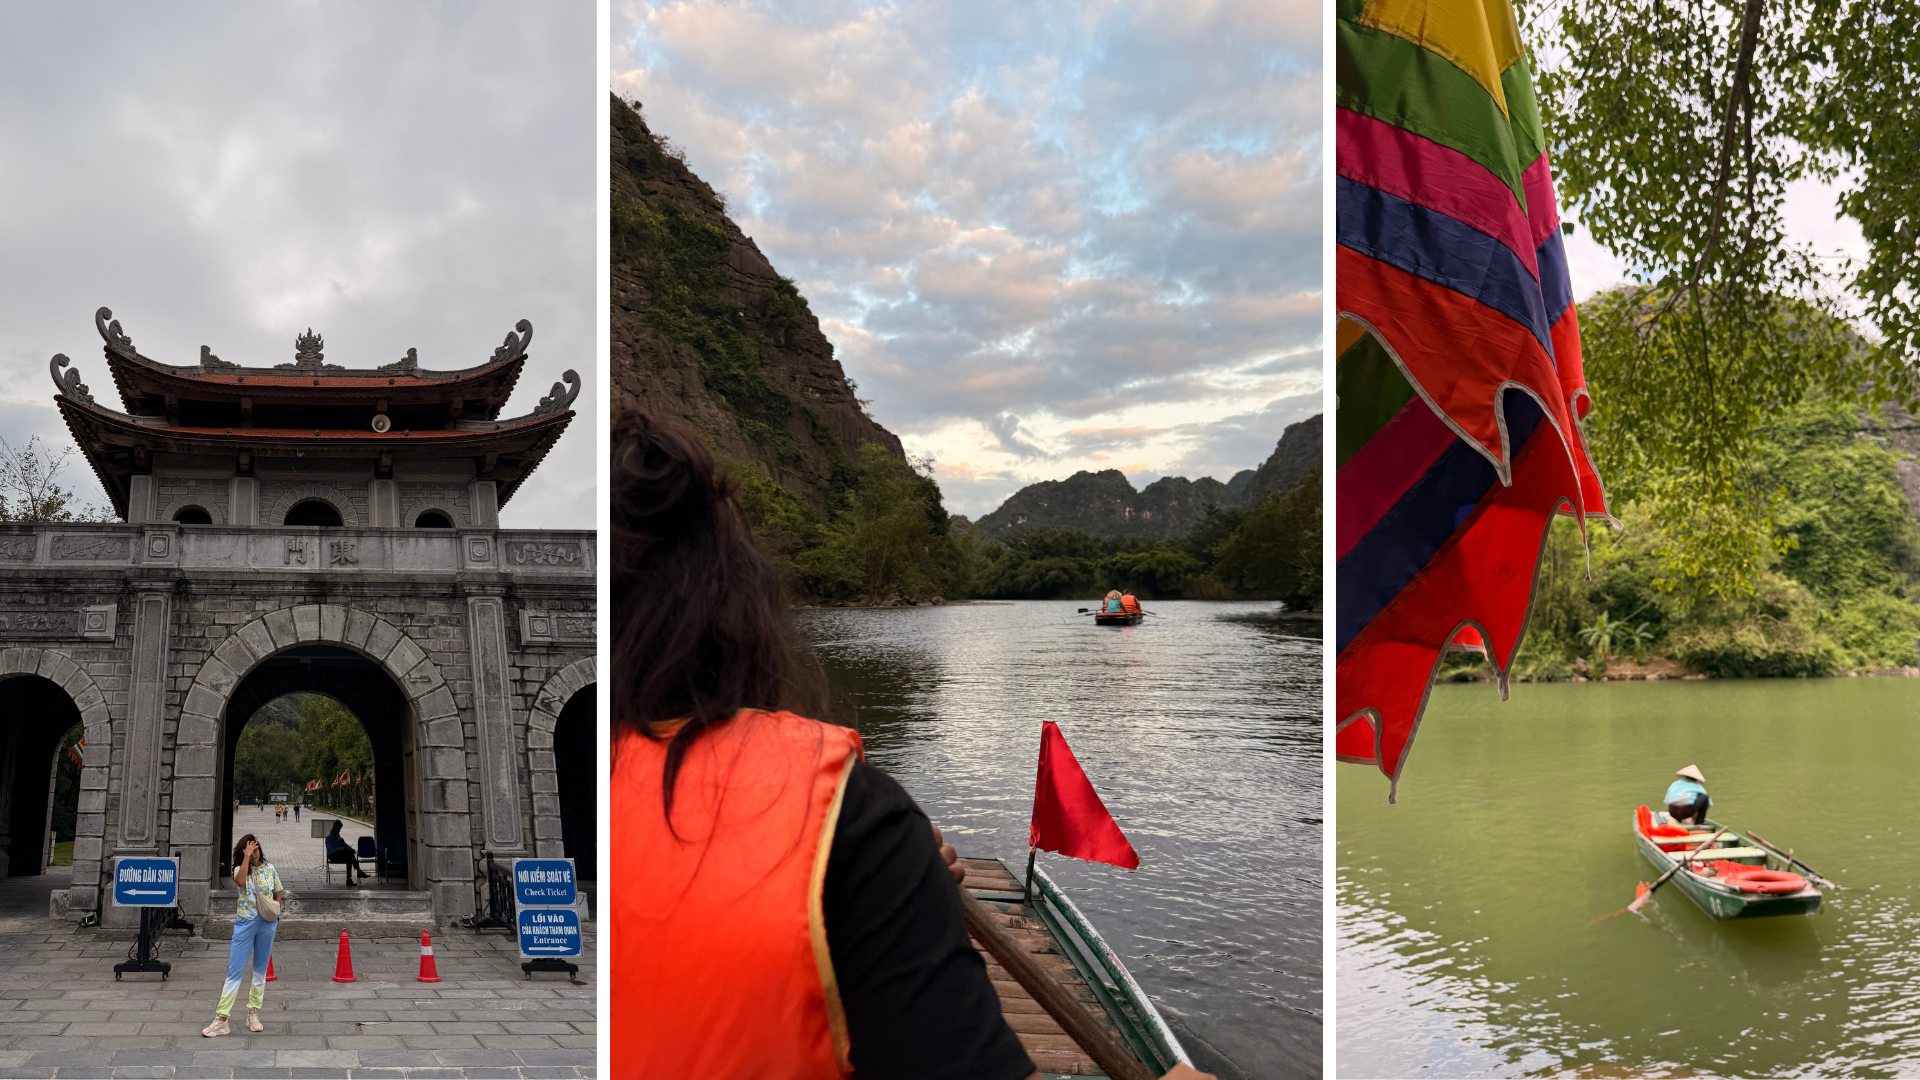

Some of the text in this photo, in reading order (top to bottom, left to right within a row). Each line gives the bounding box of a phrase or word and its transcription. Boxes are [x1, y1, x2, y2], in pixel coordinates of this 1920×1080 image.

[119, 866, 174, 882] ĐƯỜNG DÂN SINH
[518, 866, 572, 882] NƠI KIỂM SOÁT VÉ
[524, 888, 567, 896] Check Ticket
[532, 912, 564, 923] LỐI VÀO
[522, 923, 578, 935] CỦA KHÁCH THAM QUAN
[533, 936, 568, 944] Entrance
